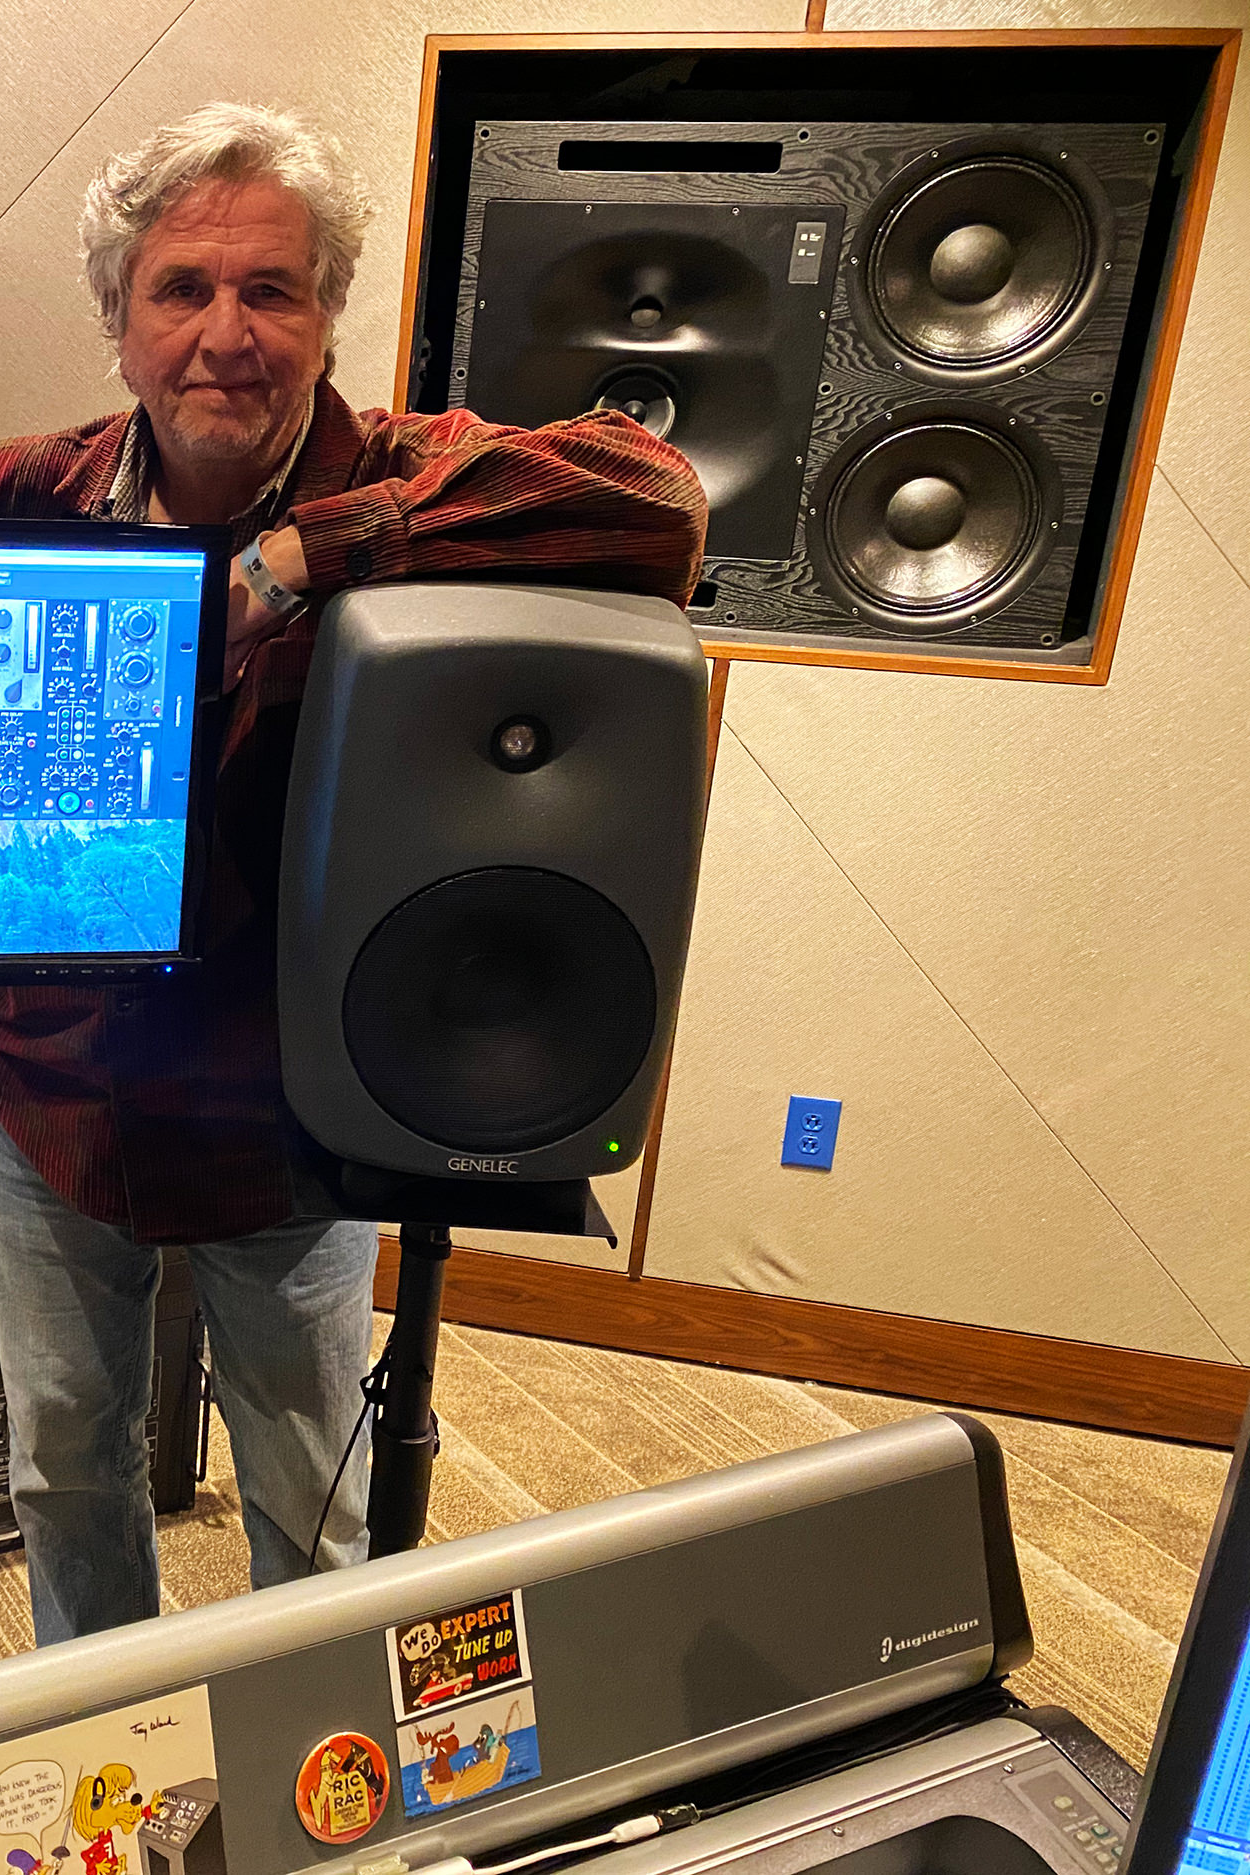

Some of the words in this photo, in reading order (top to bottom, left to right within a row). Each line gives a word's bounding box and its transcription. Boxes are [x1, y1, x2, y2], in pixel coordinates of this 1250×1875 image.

[447, 1157, 519, 1175] GENELEC
[440, 1601, 511, 1641] EXPERT
[421, 1634, 439, 1655] DO
[894, 1618, 980, 1652] digidesign
[453, 1634, 491, 1663] TUNE
[494, 1629, 513, 1650] UP
[477, 1653, 518, 1682] WORK
[34, 1771, 49, 1781] THE
[333, 1774, 361, 1793] RIC
[9, 1792, 25, 1803] WAS
[28, 1780, 62, 1798] DANGEROUS
[334, 1790, 364, 1809] RAC
[21, 1802, 35, 1813] YOU
